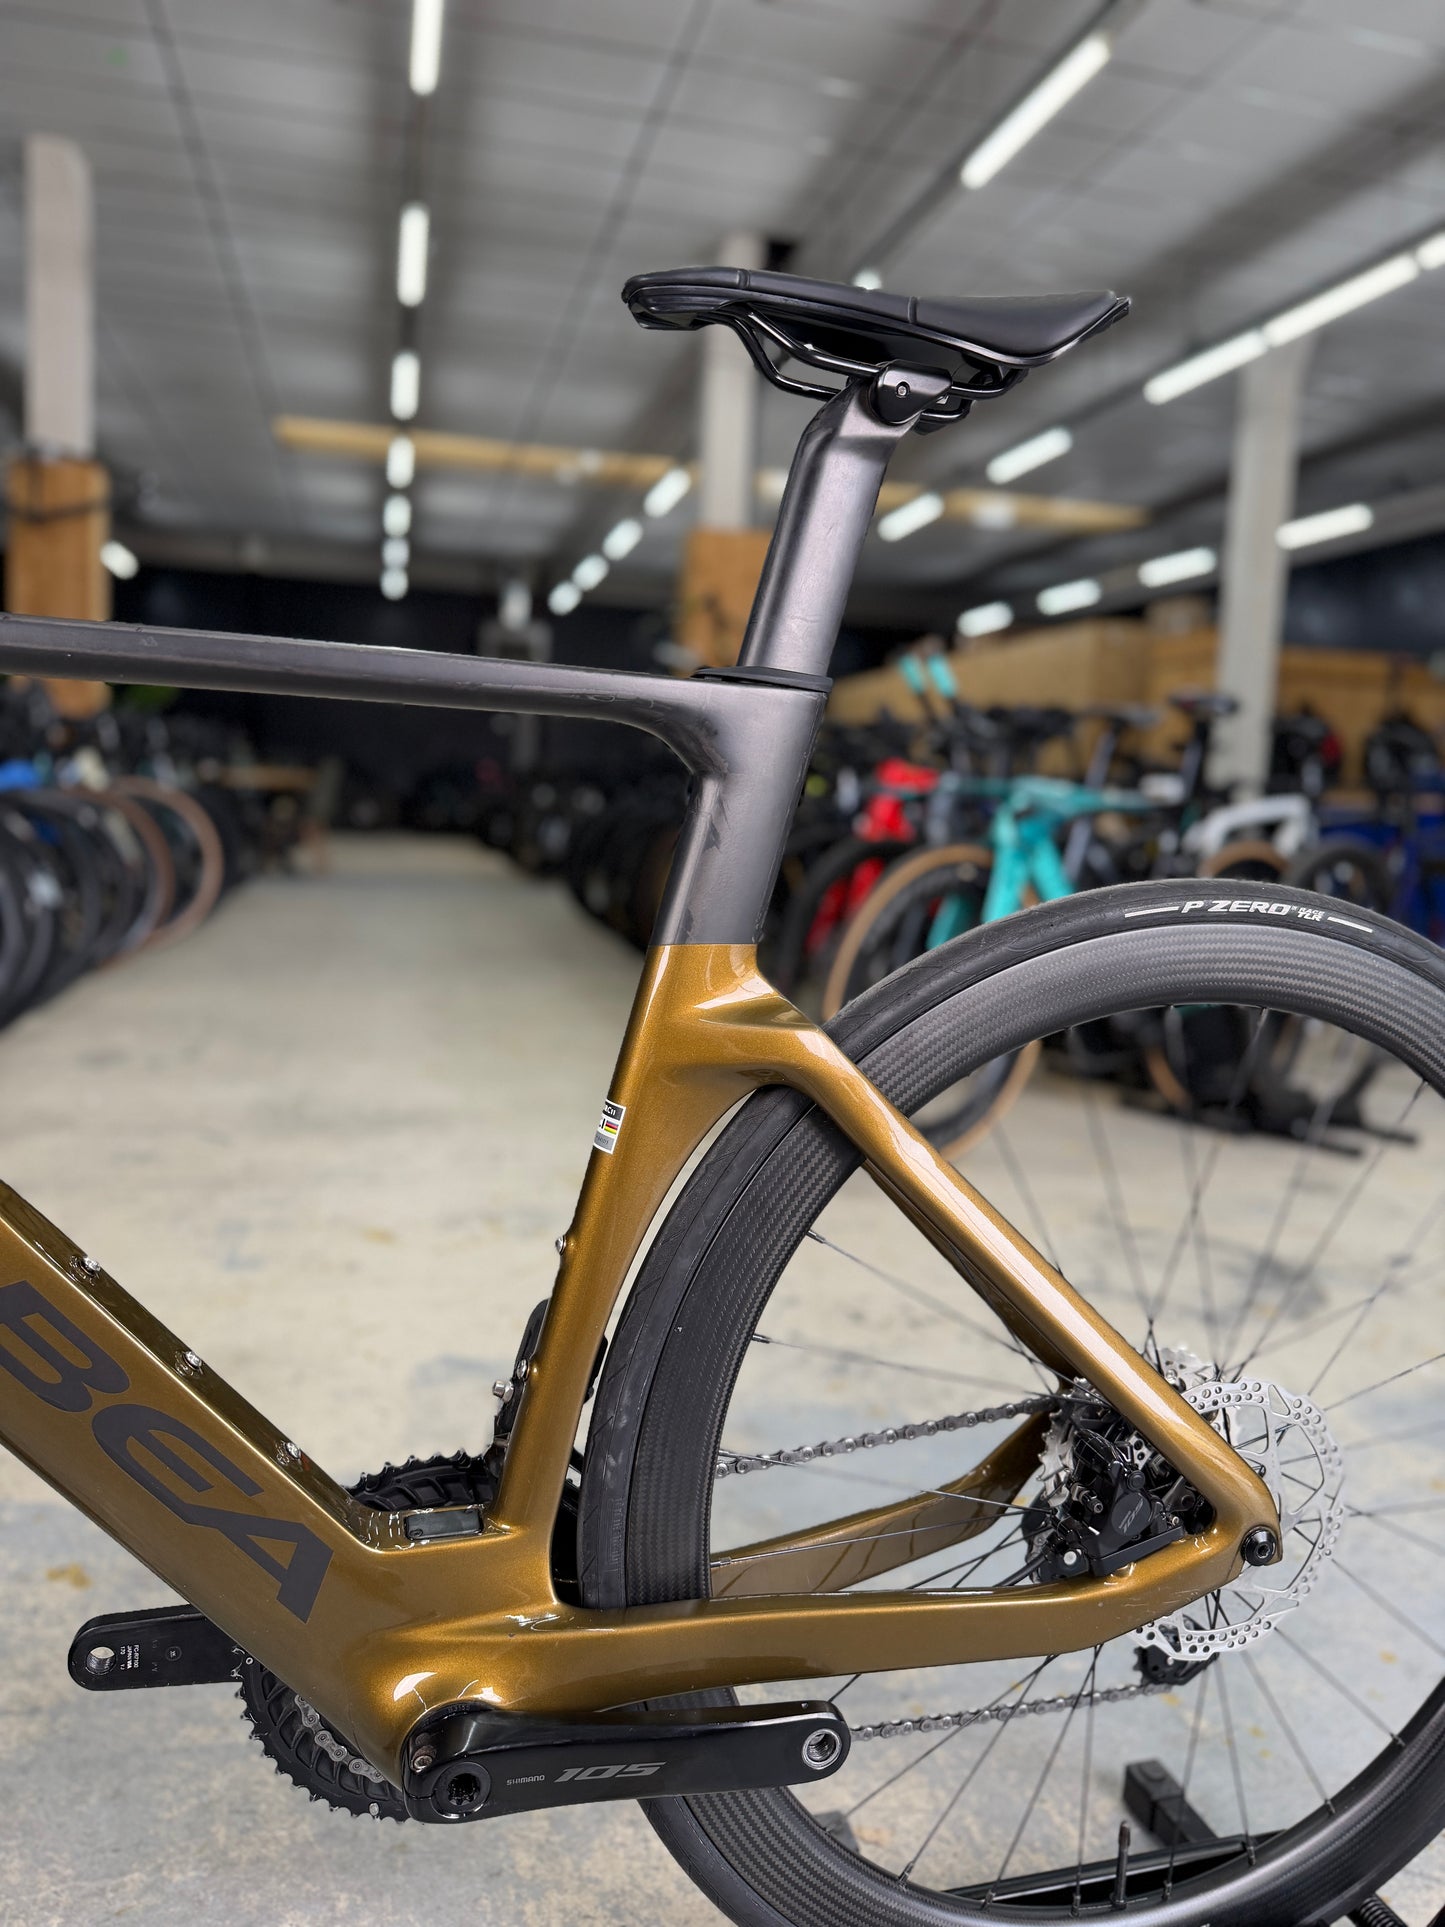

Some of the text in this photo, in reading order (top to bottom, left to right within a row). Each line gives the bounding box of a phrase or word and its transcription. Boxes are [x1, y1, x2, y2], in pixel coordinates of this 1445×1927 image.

[1181, 900, 1292, 916] P ZERO
[1298, 907, 1326, 917] RACE
[1296, 911, 1322, 922] TLR
[506, 1761, 668, 1786] SHIMANO 105
